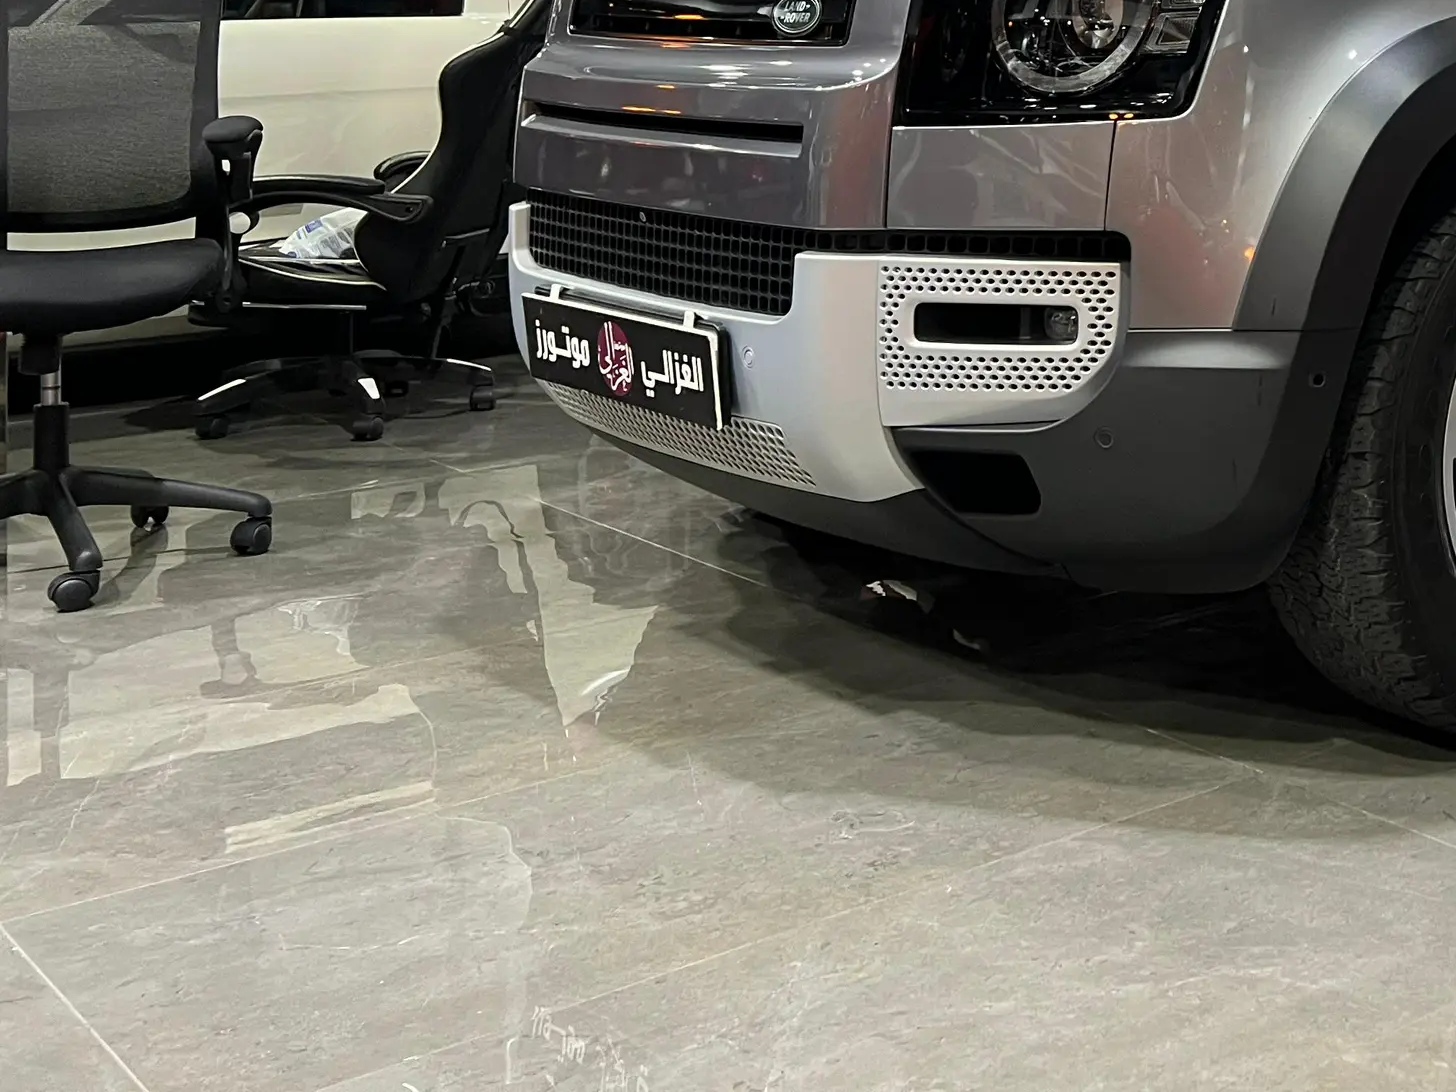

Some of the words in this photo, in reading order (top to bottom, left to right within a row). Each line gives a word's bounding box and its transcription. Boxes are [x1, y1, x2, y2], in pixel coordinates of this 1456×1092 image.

[783, 12, 811, 23] ROVER
[784, 0, 806, 12] LAND
[535, 319, 591, 370] موتورز
[641, 349, 704, 398] الغزالي
